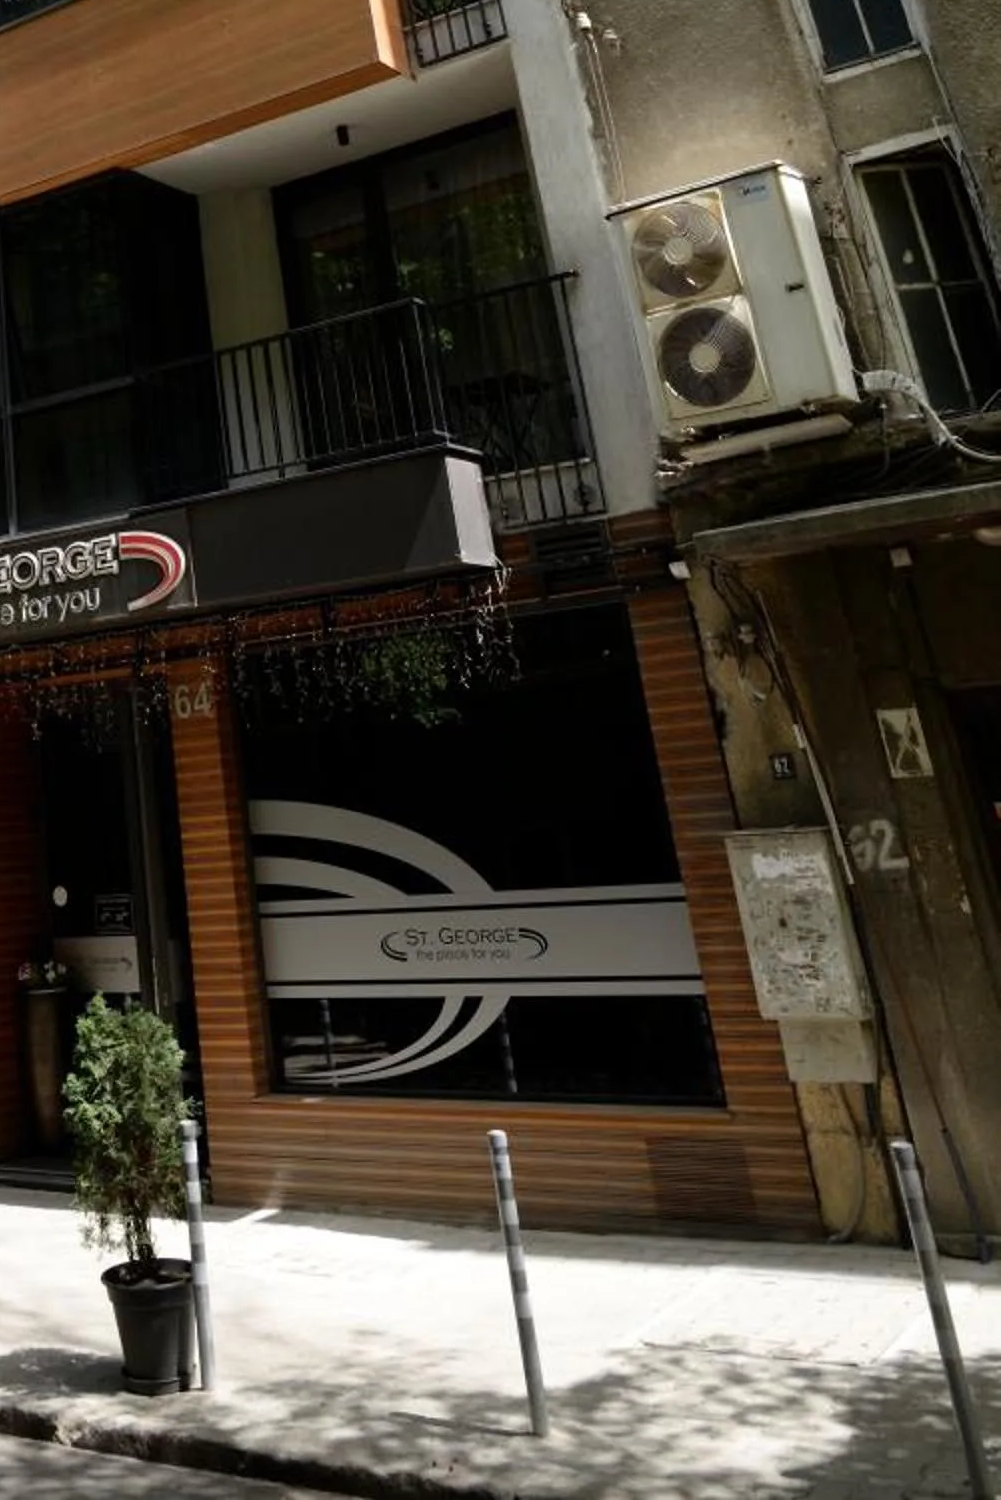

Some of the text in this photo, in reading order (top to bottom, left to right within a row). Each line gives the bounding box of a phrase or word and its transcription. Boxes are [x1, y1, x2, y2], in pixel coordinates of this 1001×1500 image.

[20, 592, 49, 622] for
[51, 587, 100, 622] you
[174, 683, 211, 718] 64
[848, 818, 910, 871] 62
[438, 927, 518, 945] GEORGE
